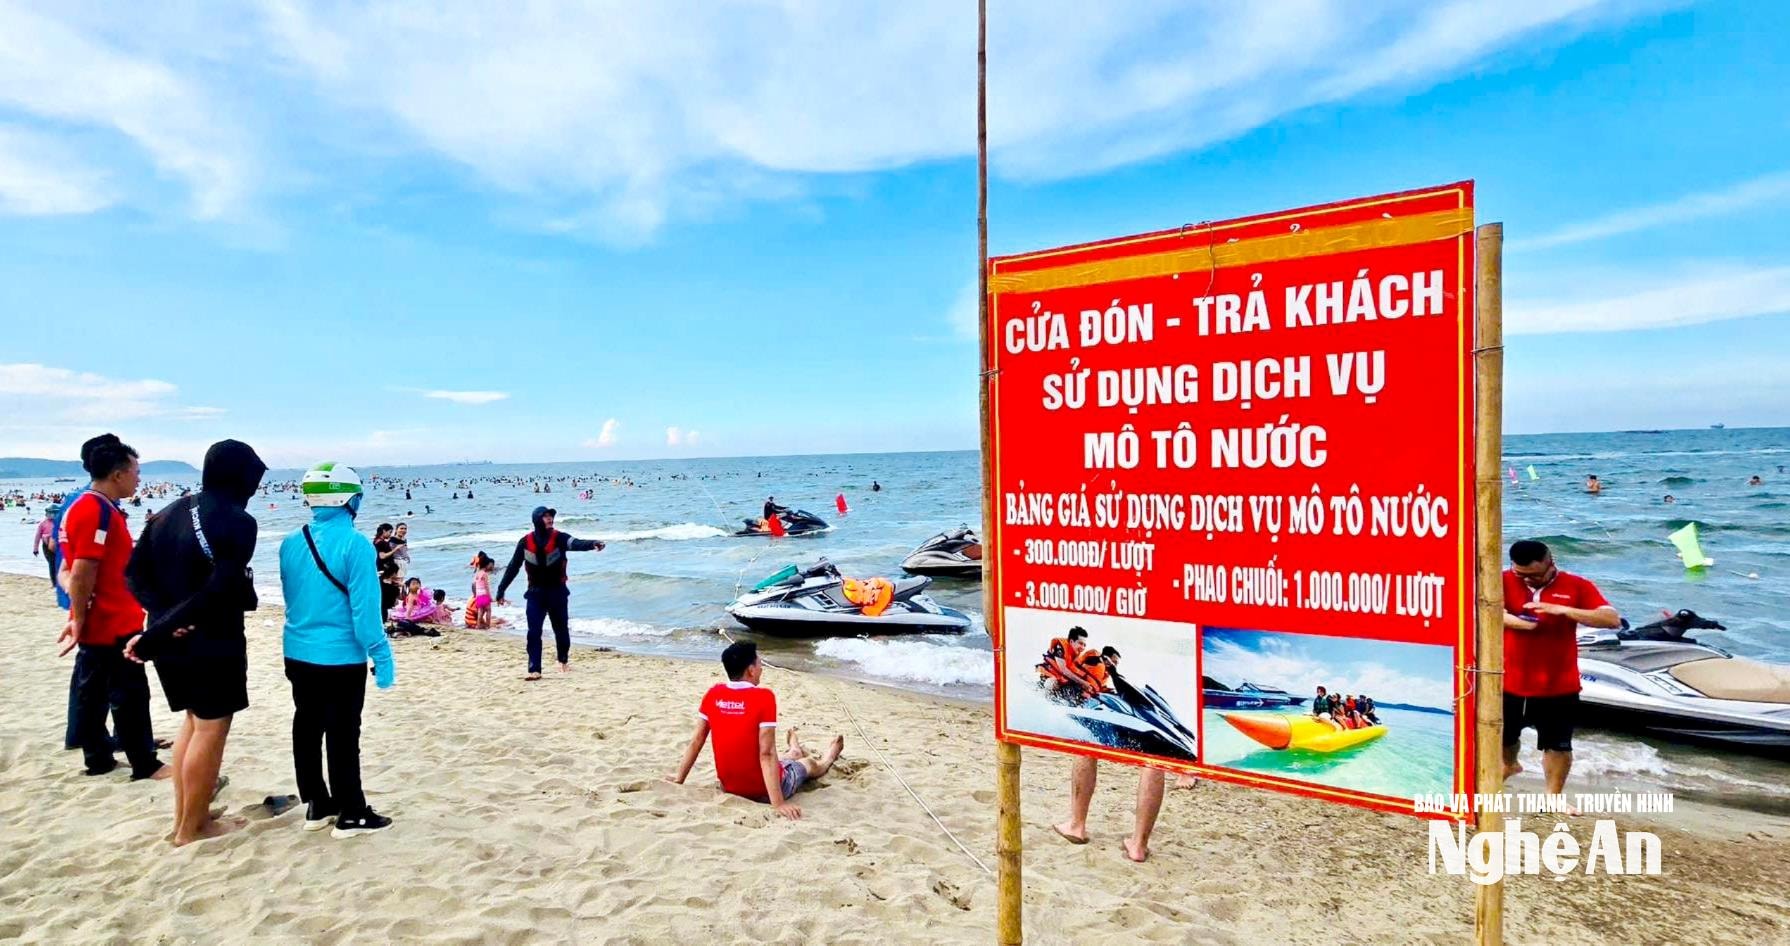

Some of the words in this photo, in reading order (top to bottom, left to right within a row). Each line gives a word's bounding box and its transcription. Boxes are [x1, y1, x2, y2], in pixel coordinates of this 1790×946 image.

[1005, 300, 1070, 354] CỬA
[1079, 299, 1153, 347] ĐÓN
[1193, 273, 1271, 336] TRẢ
[1285, 268, 1445, 328] KHÁCH
[1042, 357, 1091, 410] SỬ
[1098, 365, 1198, 414] DỤNG
[1212, 354, 1311, 409] DỊCH
[1326, 349, 1385, 403] VỤ
[1084, 423, 1139, 468] MÔ
[1151, 422, 1197, 468] TÔ
[1211, 414, 1328, 468] NƯỚC
[1005, 480, 1053, 525] BẢNG
[1057, 483, 1091, 527] GIÁ
[1094, 480, 1123, 529] SỬ
[1127, 494, 1186, 537] DỤNG
[1190, 495, 1243, 541] DỊCH
[1249, 495, 1283, 543] VỤ
[1288, 483, 1325, 535] MÔ
[1329, 483, 1364, 535] TÔ
[1370, 484, 1449, 537] NƯỚC
[1024, 539, 1108, 568] 300.000Đ/
[1110, 541, 1155, 577] LƯỢT
[1025, 581, 1111, 613] 3.000.000/
[1116, 583, 1148, 617] GIỜ
[1183, 563, 1228, 602] PHAO
[1231, 555, 1289, 607] CHUỐI:
[1293, 569, 1390, 614] 1.000.000/
[1395, 574, 1446, 627] LƯỢT
